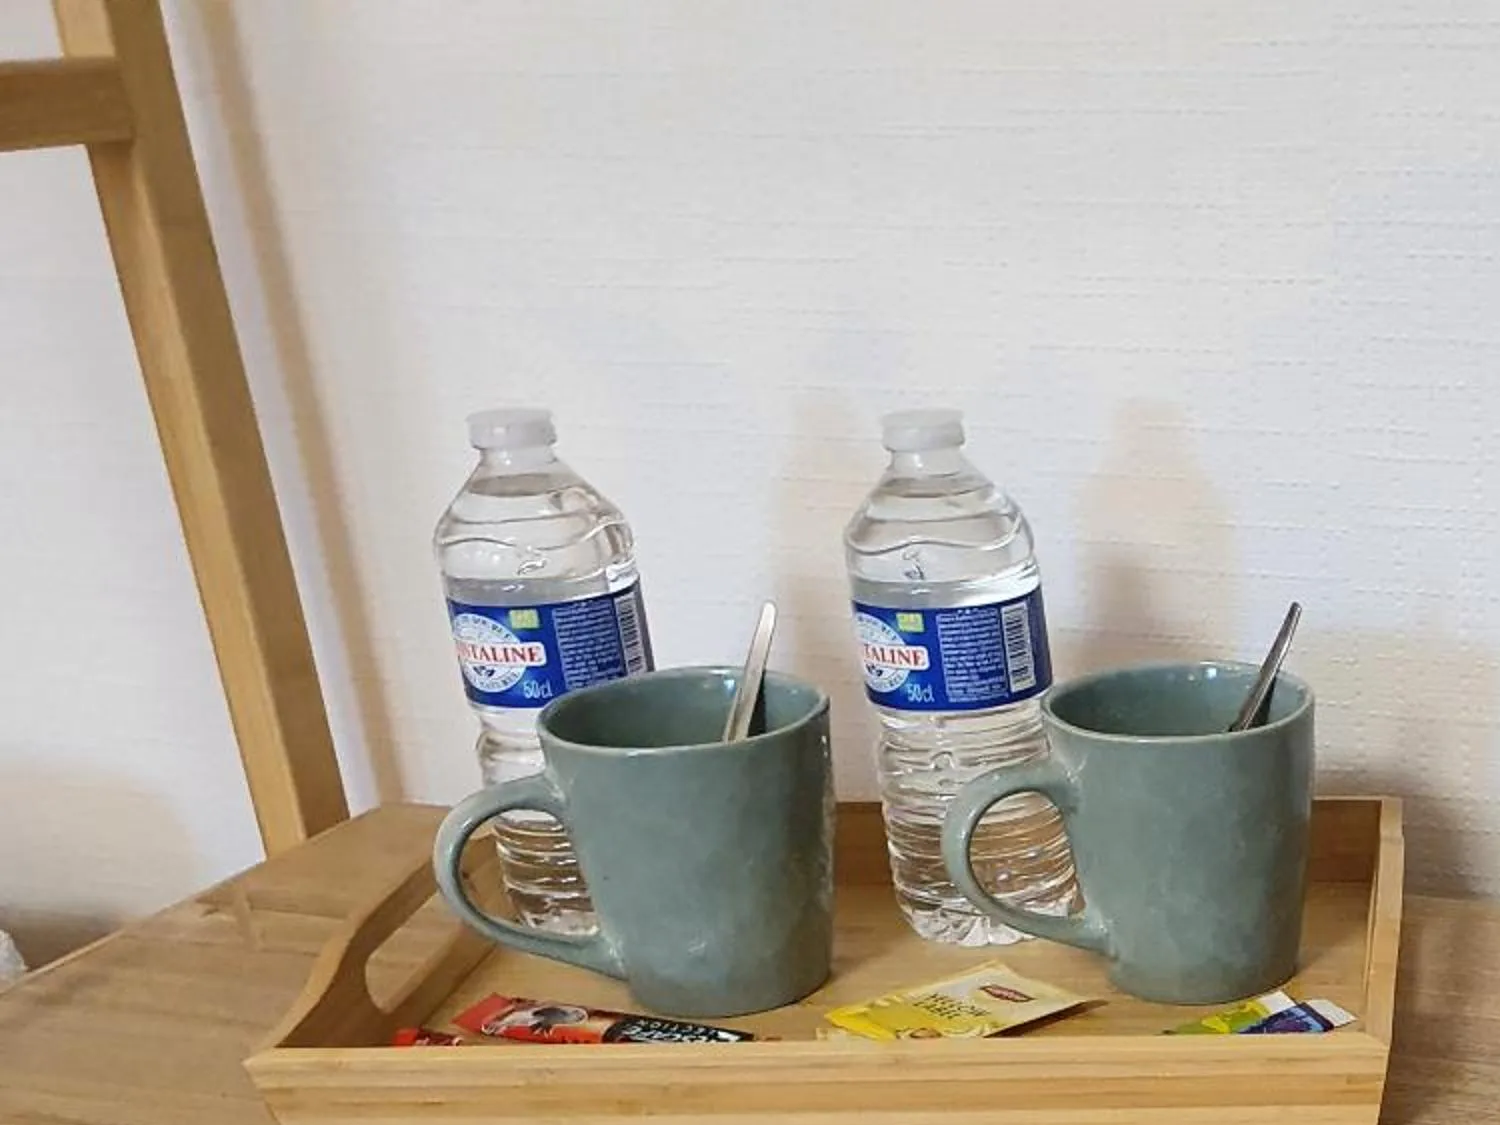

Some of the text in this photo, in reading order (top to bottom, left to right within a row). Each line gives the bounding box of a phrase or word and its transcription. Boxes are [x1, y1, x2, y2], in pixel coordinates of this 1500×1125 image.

[863, 643, 926, 666] TALINE
[523, 679, 552, 699] 50cl
[907, 682, 935, 702] 50cl
